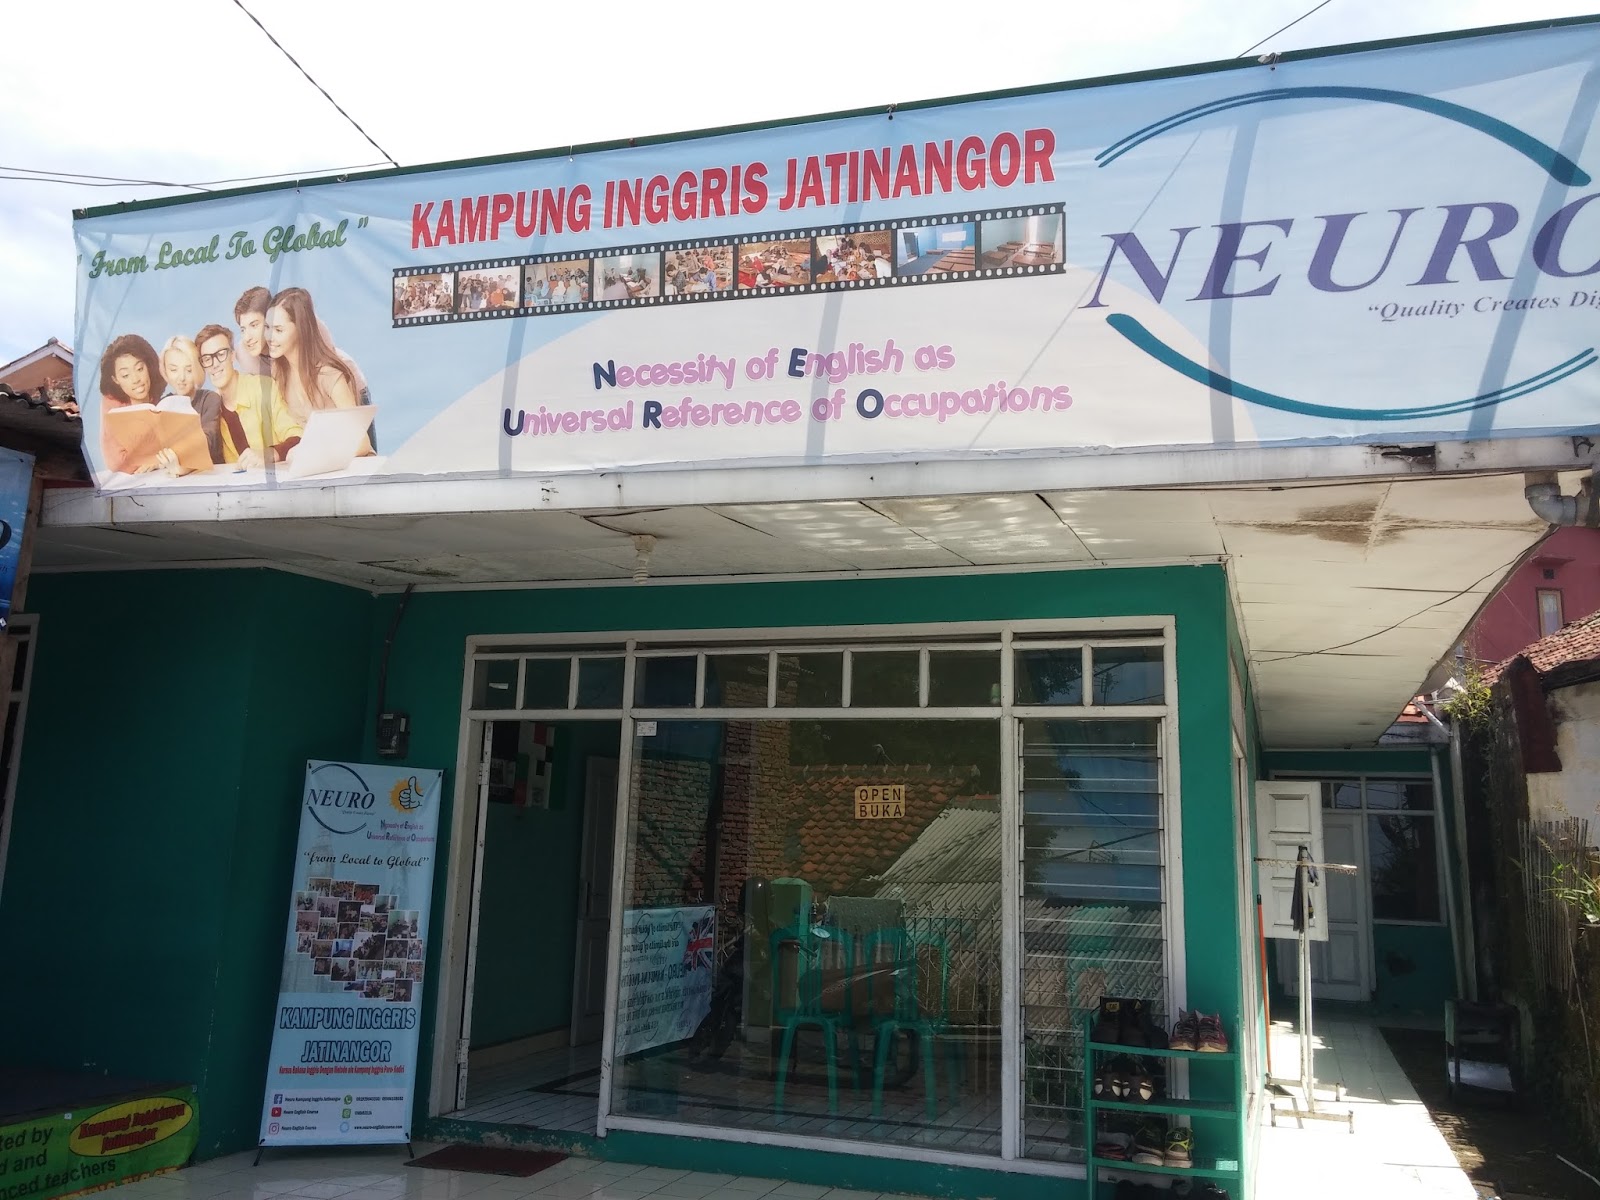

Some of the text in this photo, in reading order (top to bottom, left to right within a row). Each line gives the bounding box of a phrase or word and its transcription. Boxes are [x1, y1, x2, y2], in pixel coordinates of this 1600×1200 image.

[411, 128, 1056, 249] KAMPUNG INGGRIS JATINANGOR
[89, 250, 149, 279] From
[154, 235, 220, 271] Local
[225, 230, 257, 260] To
[263, 219, 349, 263] Global
[1473, 296, 1561, 313] Creates
[1569, 290, 1600, 310] Di
[594, 338, 956, 390] Necessity of English as
[503, 380, 1073, 438] Universal Reference of Occupations
[305, 788, 376, 810] NEURO
[859, 788, 901, 801] OPEN
[859, 804, 902, 818] BUKA
[340, 853, 371, 865] Local
[373, 857, 384, 866] to
[280, 1007, 416, 1029] KAMPUNG INGGRIS
[300, 1040, 392, 1063] JATINANGOR
[31, 1126, 54, 1146] by
[13, 1148, 48, 1173] and
[44, 1158, 117, 1188] teachers
